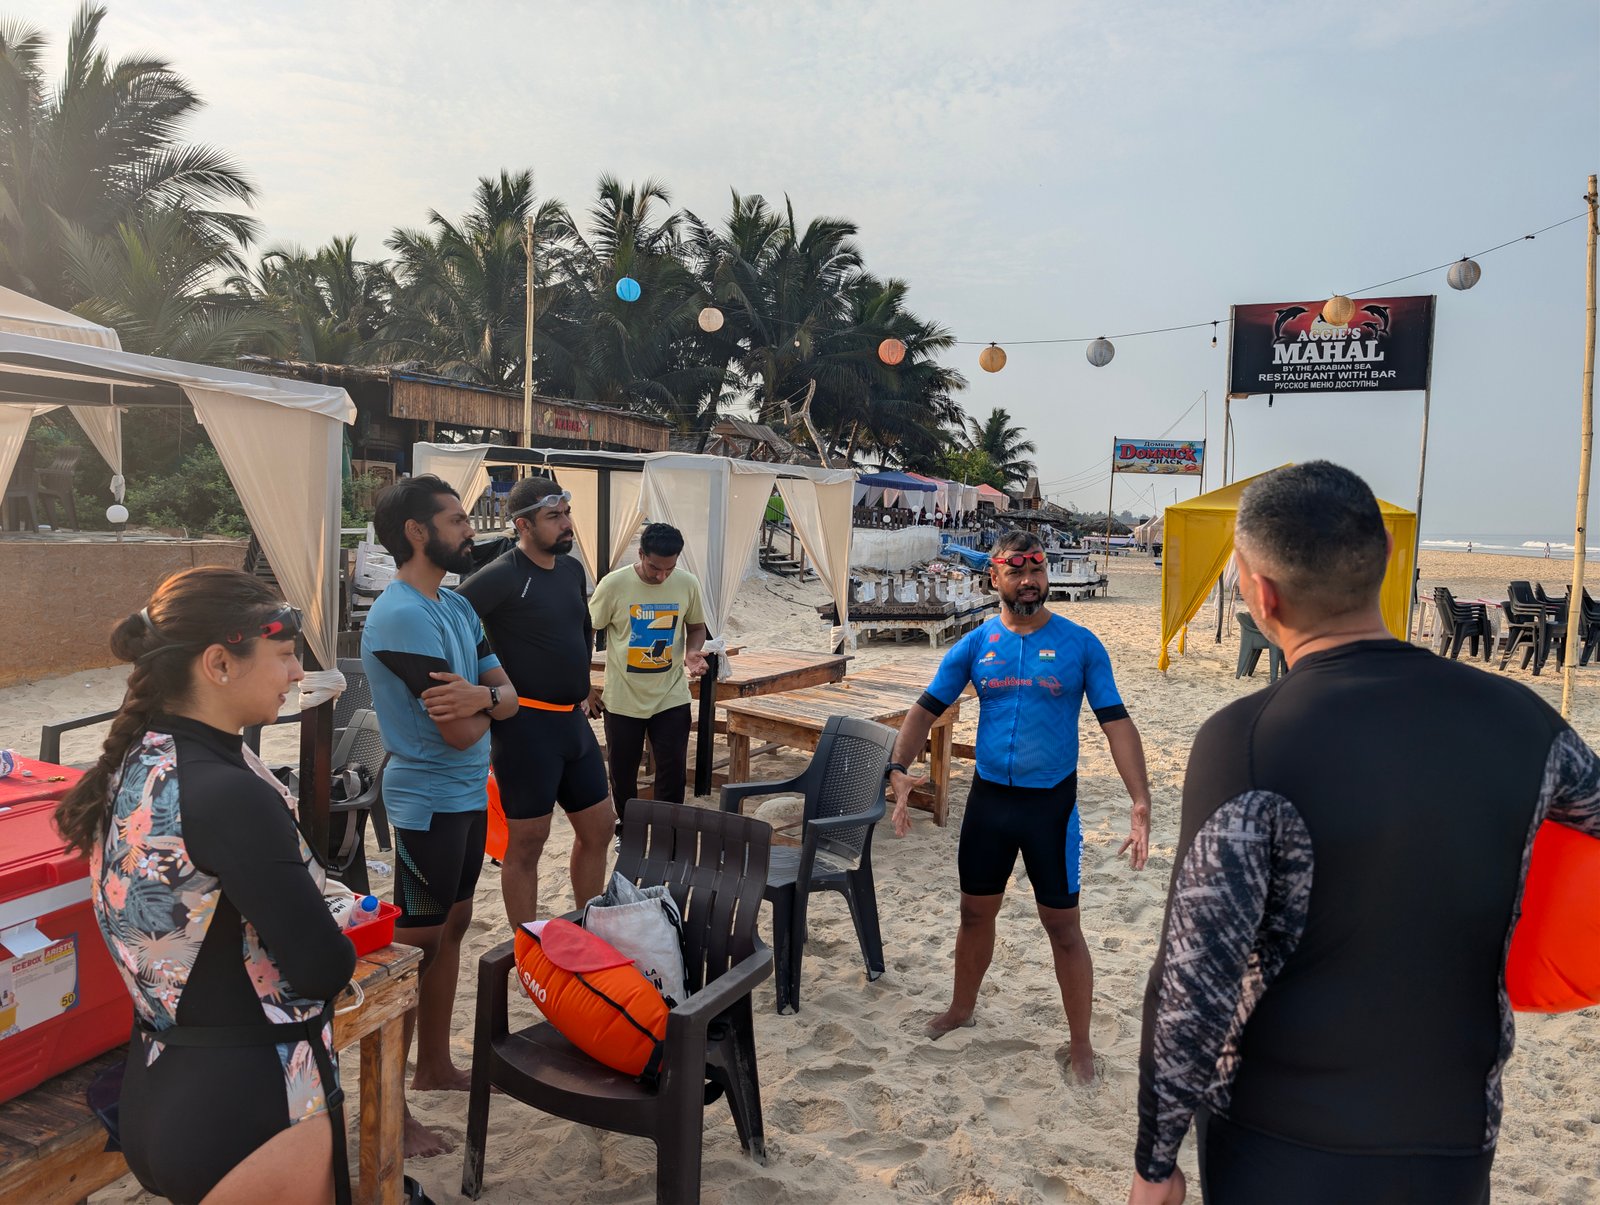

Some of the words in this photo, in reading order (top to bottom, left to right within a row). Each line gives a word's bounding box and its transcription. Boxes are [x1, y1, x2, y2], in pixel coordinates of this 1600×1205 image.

[1297, 327, 1361, 342] AGGIE'S
[1272, 340, 1384, 365] MAHAL
[1258, 371, 1334, 382] RESTAURANT
[1337, 370, 1368, 380] WITH
[1370, 369, 1396, 379] BAR
[1274, 381, 1309, 390] РУССКОЕ
[1310, 380, 1334, 389] МЕНЮ
[1335, 379, 1379, 389] ДОСТУПНЫ
[636, 608, 655, 620] Sun
[12, 955, 42, 973] ICEBOX
[61, 993, 75, 1007] 50
